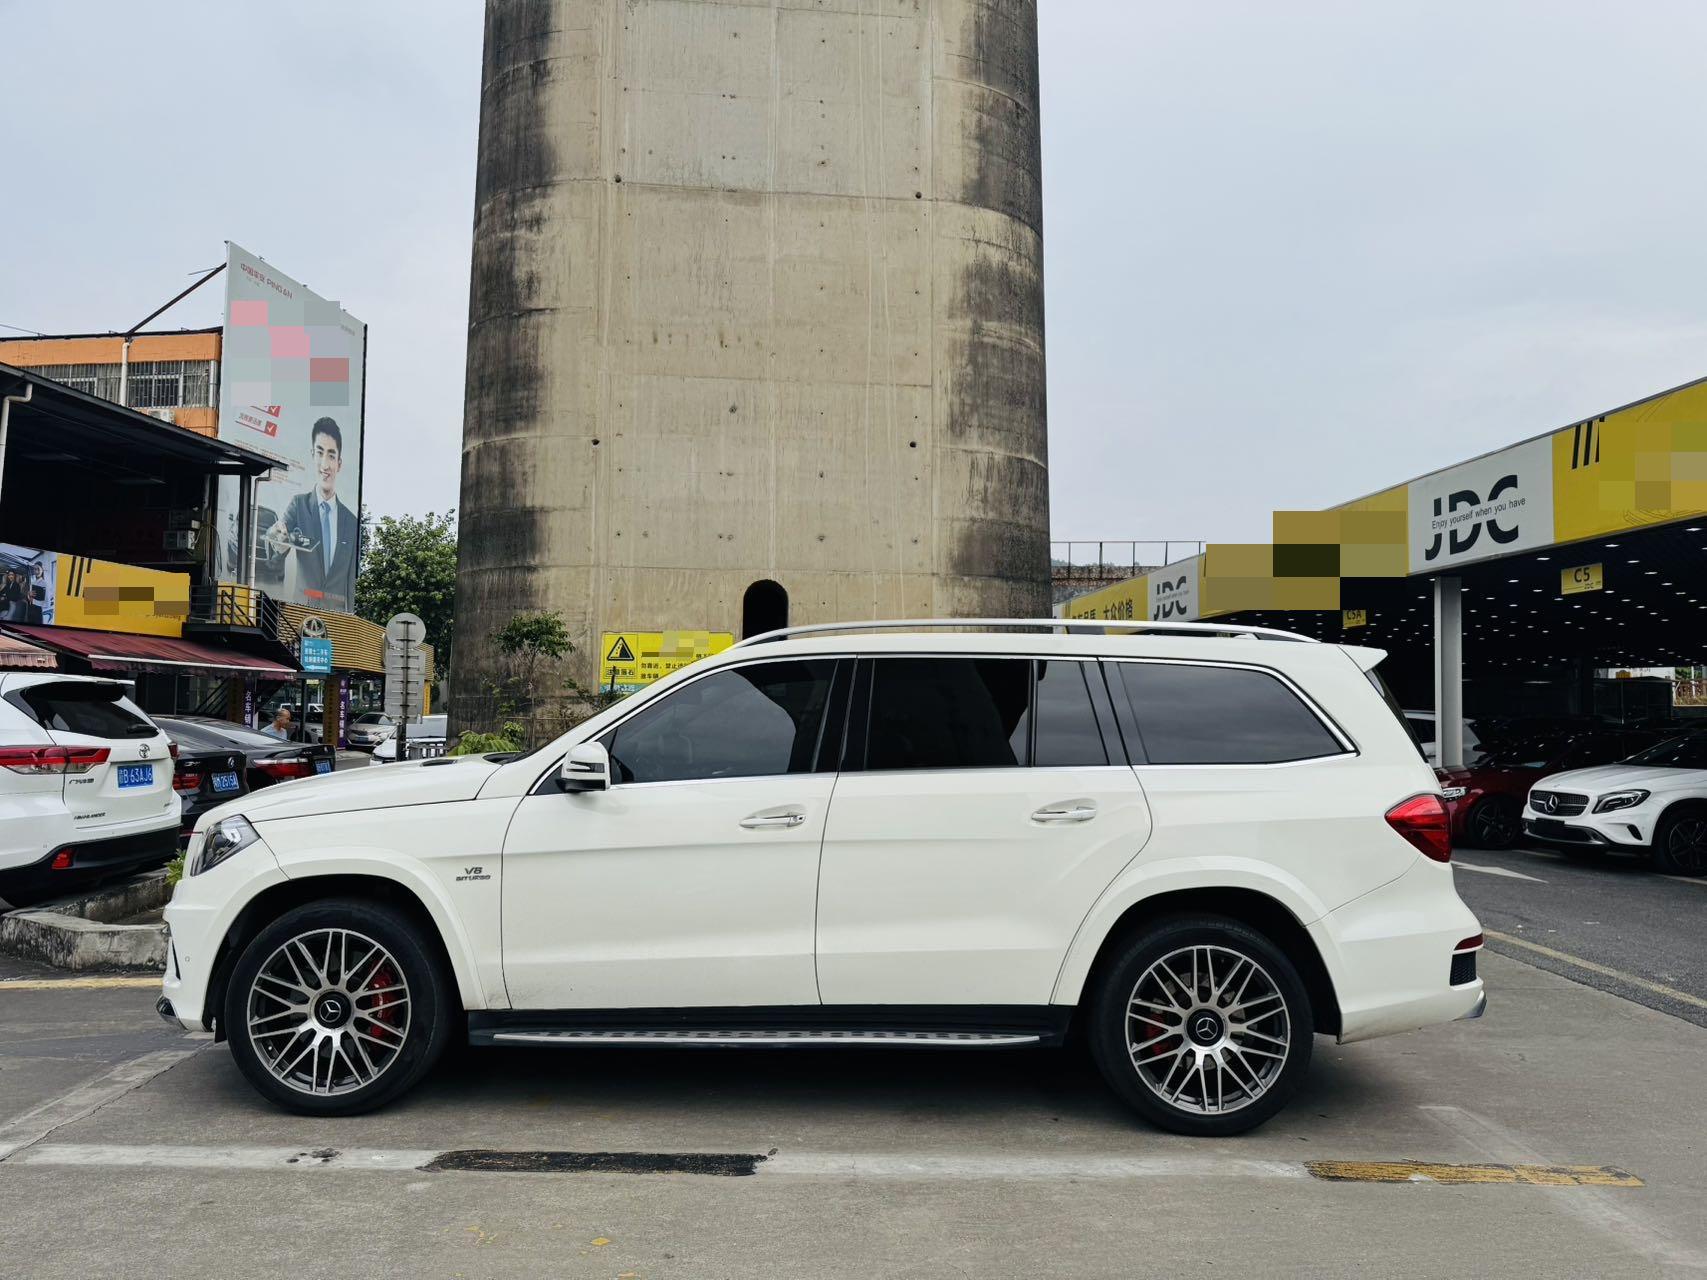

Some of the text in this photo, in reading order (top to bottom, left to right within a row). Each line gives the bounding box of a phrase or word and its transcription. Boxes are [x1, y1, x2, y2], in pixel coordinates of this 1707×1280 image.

[1425, 474, 1519, 561] JDC
[1432, 497, 1526, 530] Enjoy yourself when you have
[1574, 567, 1590, 583] C5
[1153, 575, 1187, 621] JDC
[464, 866, 483, 875] V8
